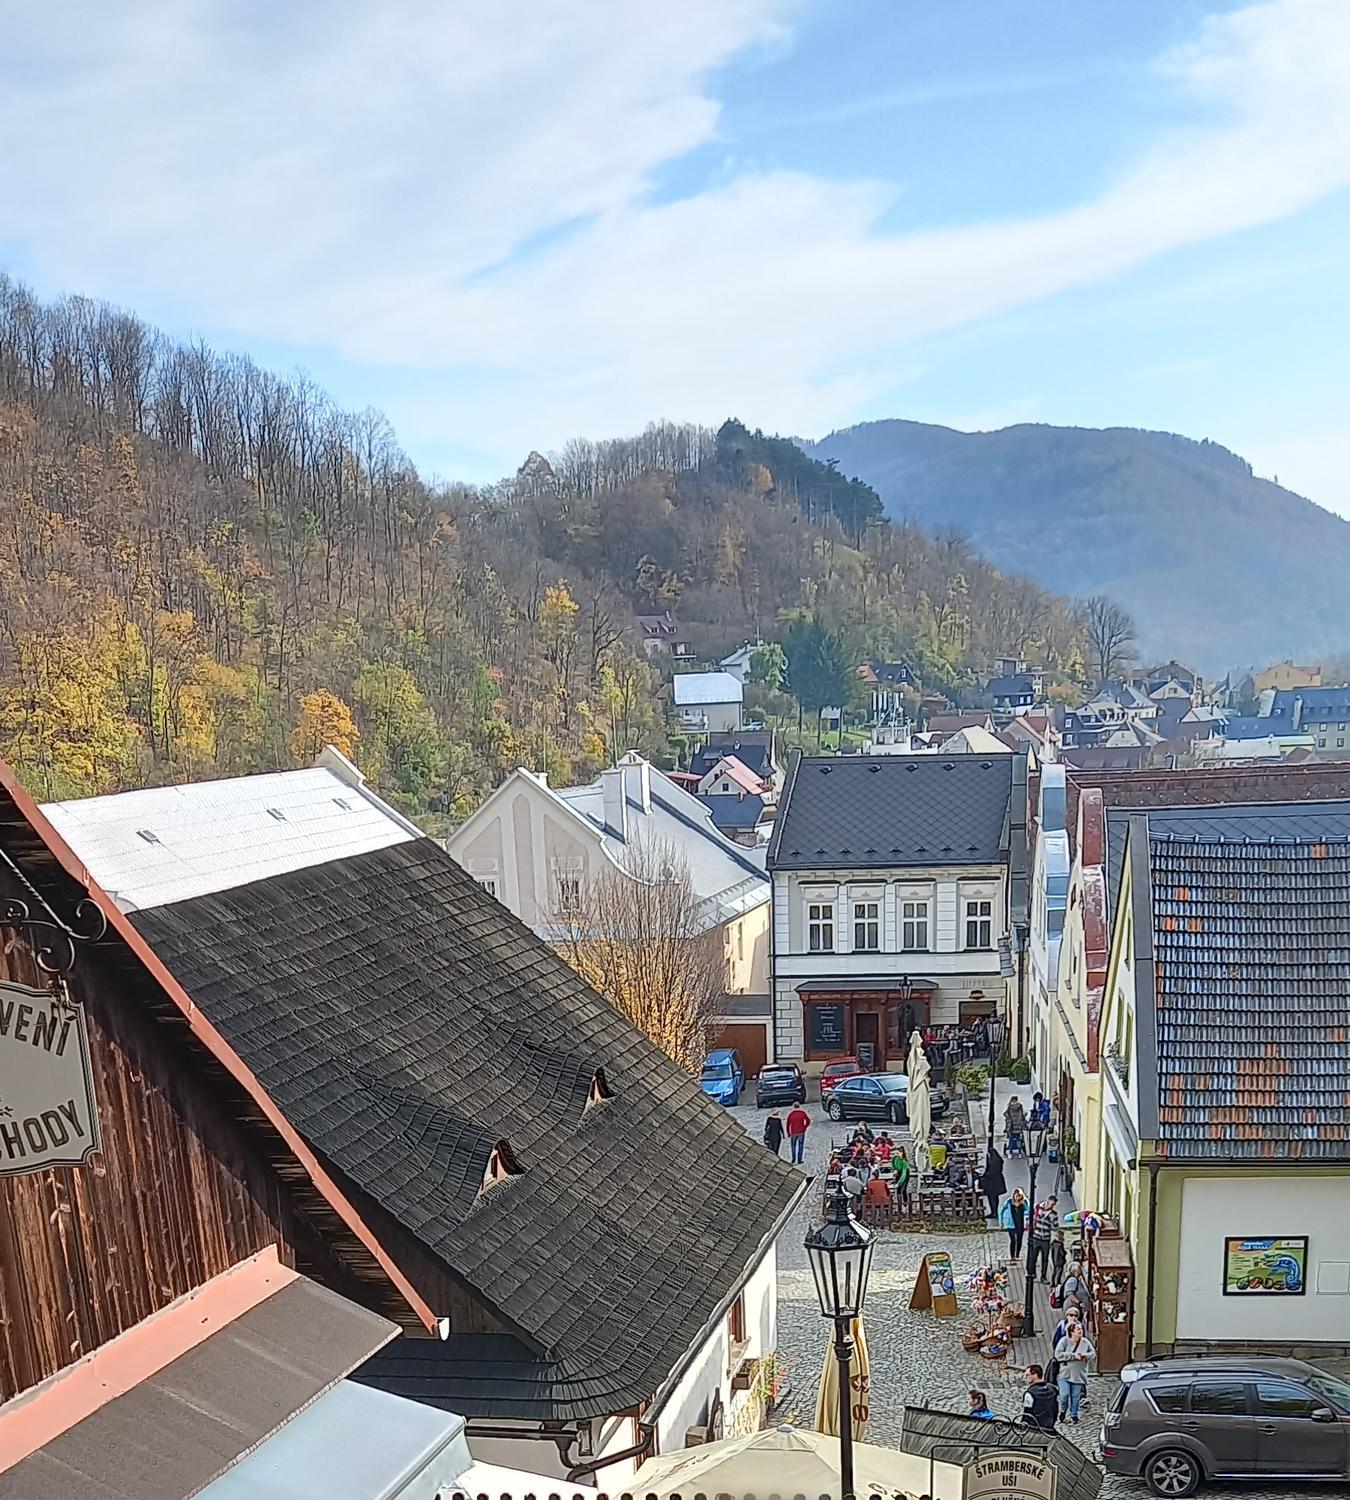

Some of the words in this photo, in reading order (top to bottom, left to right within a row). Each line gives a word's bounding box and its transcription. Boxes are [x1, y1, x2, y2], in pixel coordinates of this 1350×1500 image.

[0, 1100, 84, 1160] HODY
[975, 1460, 1047, 1481] ŠTRAMBERSKÉ
[1002, 1472, 1017, 1487] UŠI
